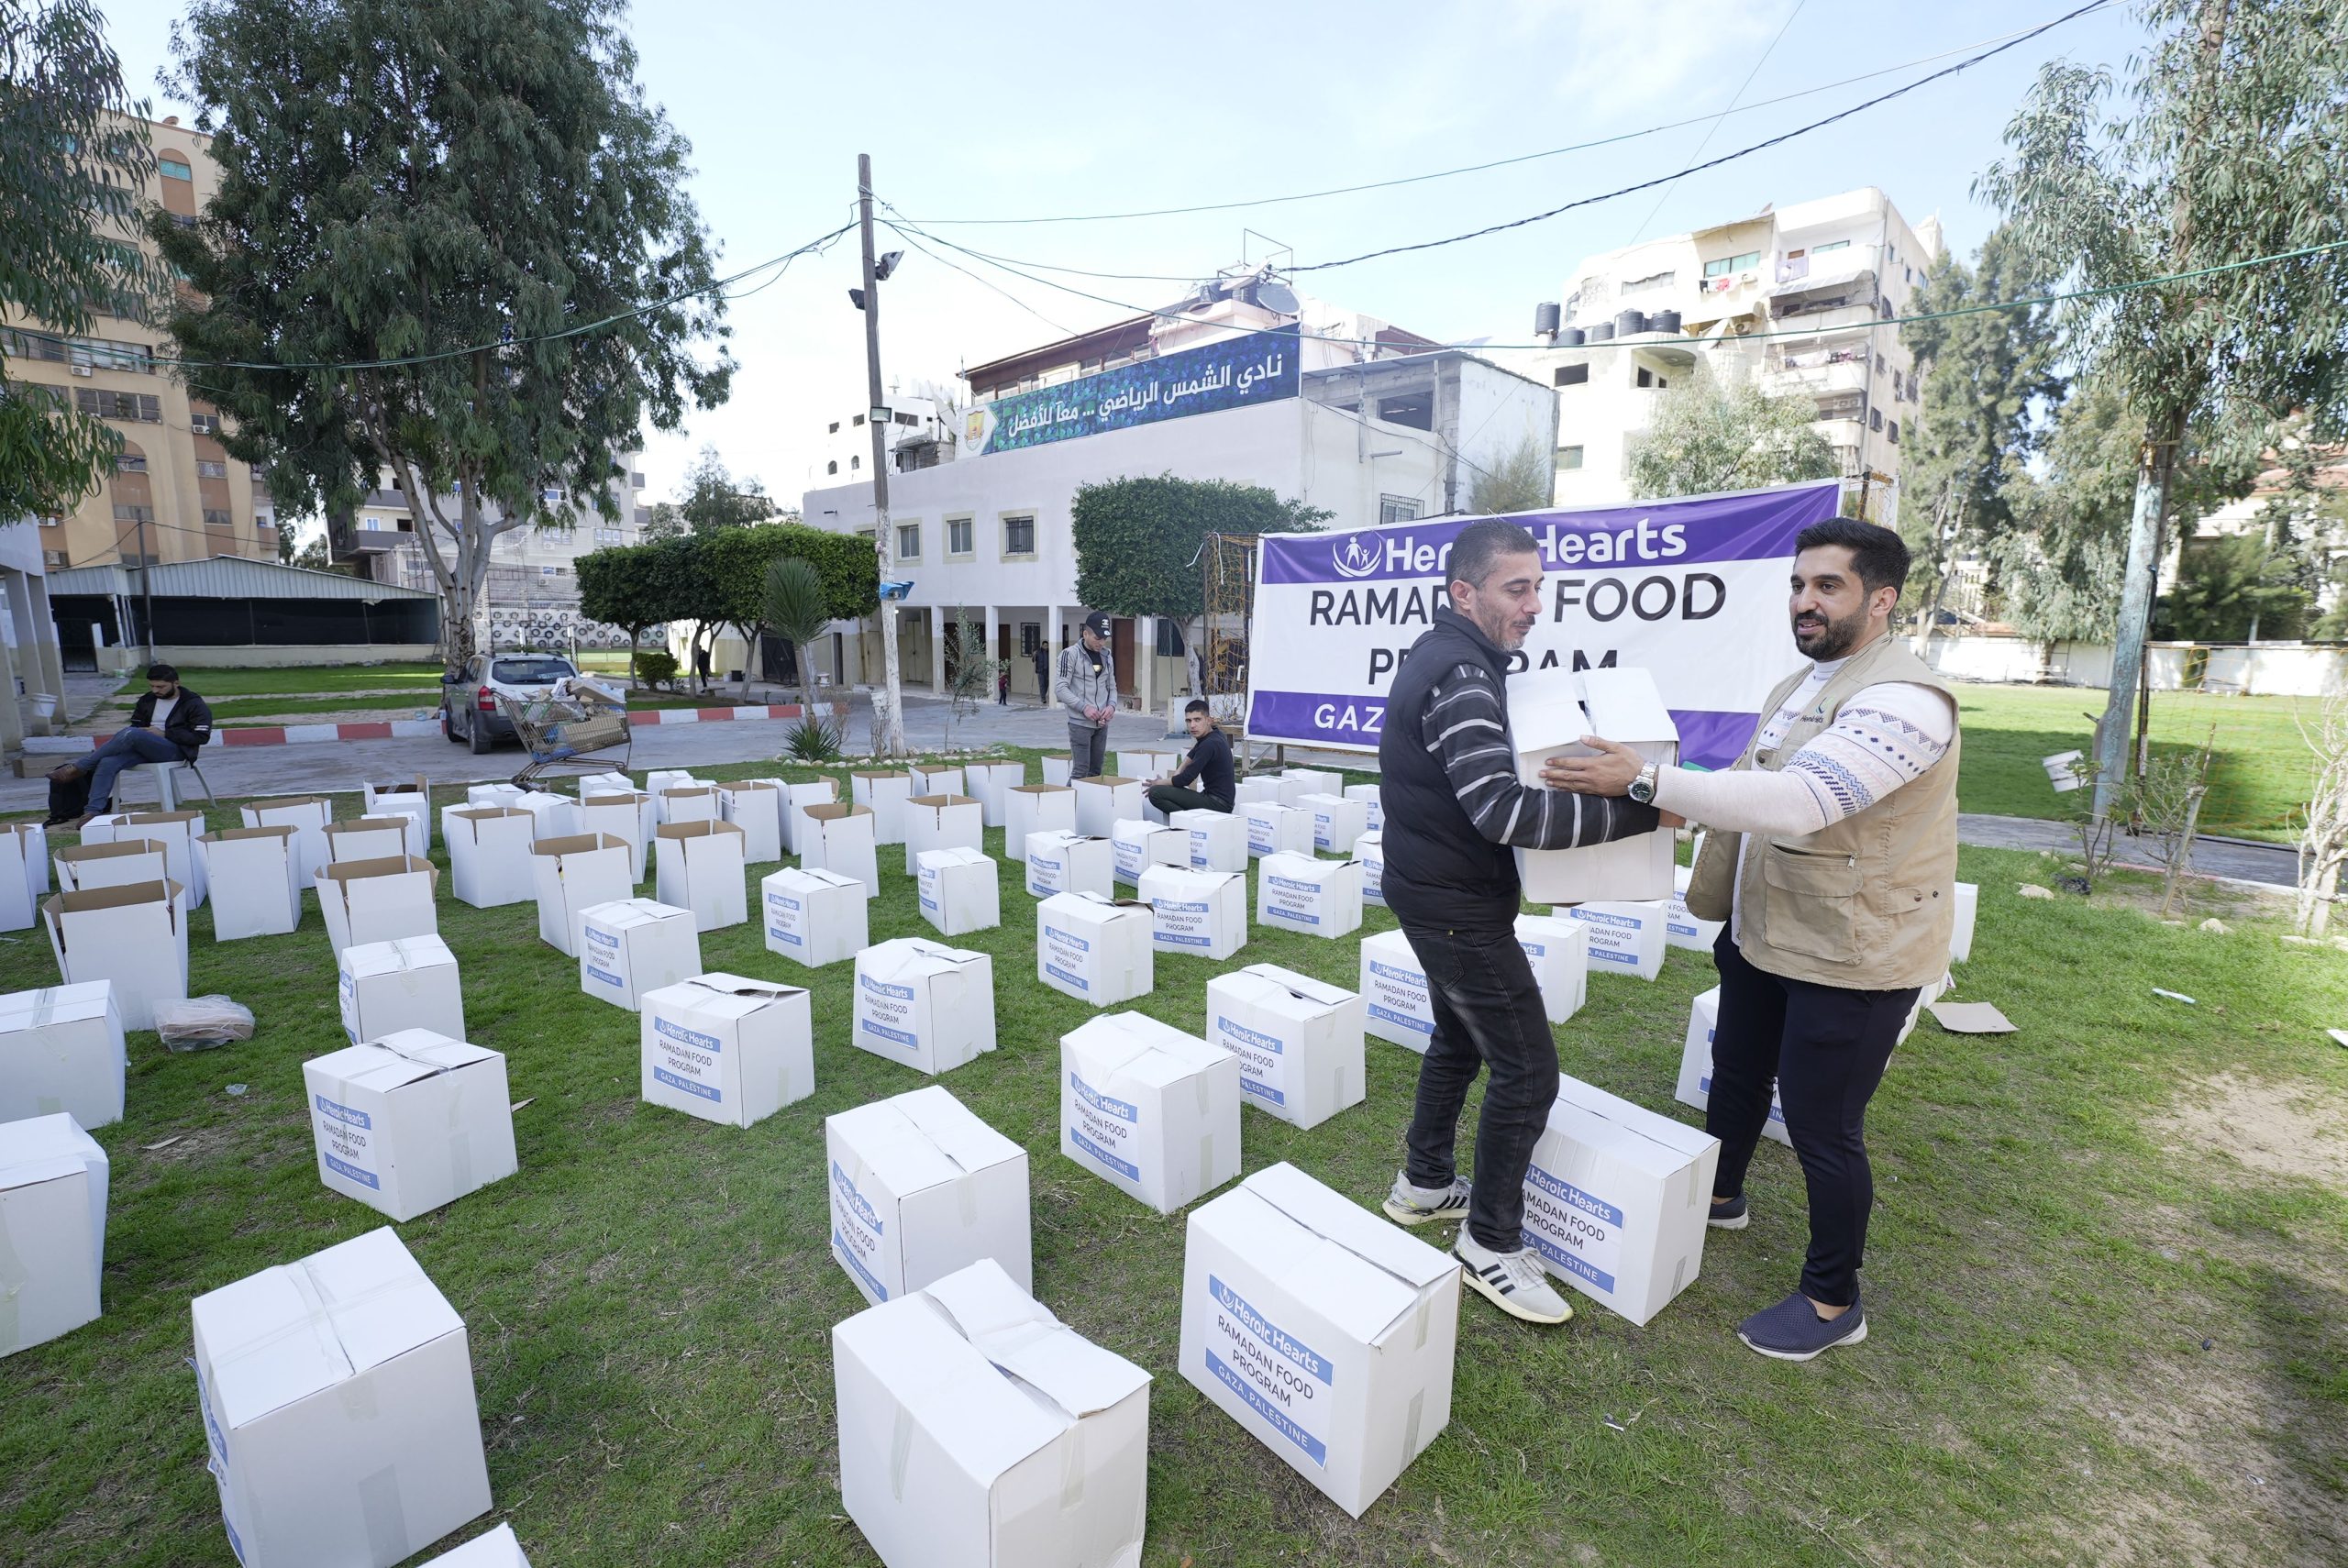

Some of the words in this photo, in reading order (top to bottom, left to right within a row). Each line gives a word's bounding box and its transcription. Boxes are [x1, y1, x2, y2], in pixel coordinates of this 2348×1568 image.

[1163, 364, 1231, 404] الشمس
[1236, 353, 1282, 395] نادي
[1099, 381, 1158, 422] الرياضي
[1009, 403, 1052, 437] للأفضل
[1554, 572, 1726, 623] FOOD
[1272, 889, 1298, 900] RAMADAN
[1298, 894, 1314, 903] FOOD
[1279, 878, 1296, 889] Heroic
[1296, 882, 1315, 892] Hearts
[1165, 901, 1183, 911] Heroic
[1183, 903, 1203, 911] Hearts
[1279, 899, 1305, 910] PROGRAM
[1157, 913, 1184, 922] RAMADAN
[1166, 922, 1194, 933] PROGRAM
[1586, 911, 1610, 924] Heroic
[1610, 916, 1634, 927] Hearts
[1589, 925, 1610, 936] ADAN
[1611, 930, 1632, 940] FOOD
[1589, 935, 1620, 947] ROGRAM
[1595, 950, 1629, 961] PALESTINE
[1382, 966, 1404, 981] Heroic
[869, 979, 886, 995] Heroic
[886, 985, 908, 999] Hearts
[1374, 980, 1406, 996] RAMADAN
[1407, 990, 1427, 1003] FOOD
[865, 994, 889, 1010] RAMADAN
[890, 1003, 908, 1014] FOOD
[1383, 995, 1416, 1011] PROGRAM
[871, 1009, 900, 1025] PROGRAM
[1393, 1014, 1426, 1031] PALESTINE
[667, 1023, 688, 1042] Heroic
[688, 1032, 714, 1049] Hearts
[1231, 1023, 1251, 1043] Heroic
[1251, 1032, 1276, 1051] Hearts
[659, 1039, 691, 1060] RAMADAN
[692, 1052, 713, 1066] FOOD
[1253, 1053, 1274, 1068] FOOD
[668, 1056, 701, 1077] PROGRAM
[660, 1072, 678, 1087] GAZA,
[678, 1080, 712, 1098] PALESTINE
[1241, 1079, 1275, 1099] PALESTINE
[327, 1101, 344, 1120] Heroic
[344, 1110, 365, 1126] Hearts
[1081, 1085, 1101, 1109] Heroic
[1101, 1097, 1129, 1119] Hearts
[1074, 1099, 1102, 1129] RAMADAN
[1104, 1121, 1127, 1139] FOOD
[322, 1120, 348, 1141] RAMADAN
[348, 1132, 367, 1147] FOOD
[1082, 1121, 1116, 1149] PROGRAM
[331, 1139, 360, 1160] PROGRAM
[1530, 1166, 1567, 1199] Heroic
[1567, 1187, 1611, 1220] Hearts
[1523, 1189, 1567, 1223] AMADAN
[1570, 1216, 1605, 1242] FOOD
[1526, 1209, 1584, 1250] PROGRAM
[1541, 1243, 1598, 1281] PALESTINE
[1234, 1297, 1270, 1343] Heroic
[1272, 1330, 1319, 1374] Hearts
[1218, 1314, 1273, 1372] RAMADAN
[1276, 1364, 1313, 1399] FOOD
[1233, 1349, 1291, 1408] PROGRAM
[1218, 1364, 1247, 1398] GAZA,
[1249, 1391, 1308, 1448] PALESTINE
